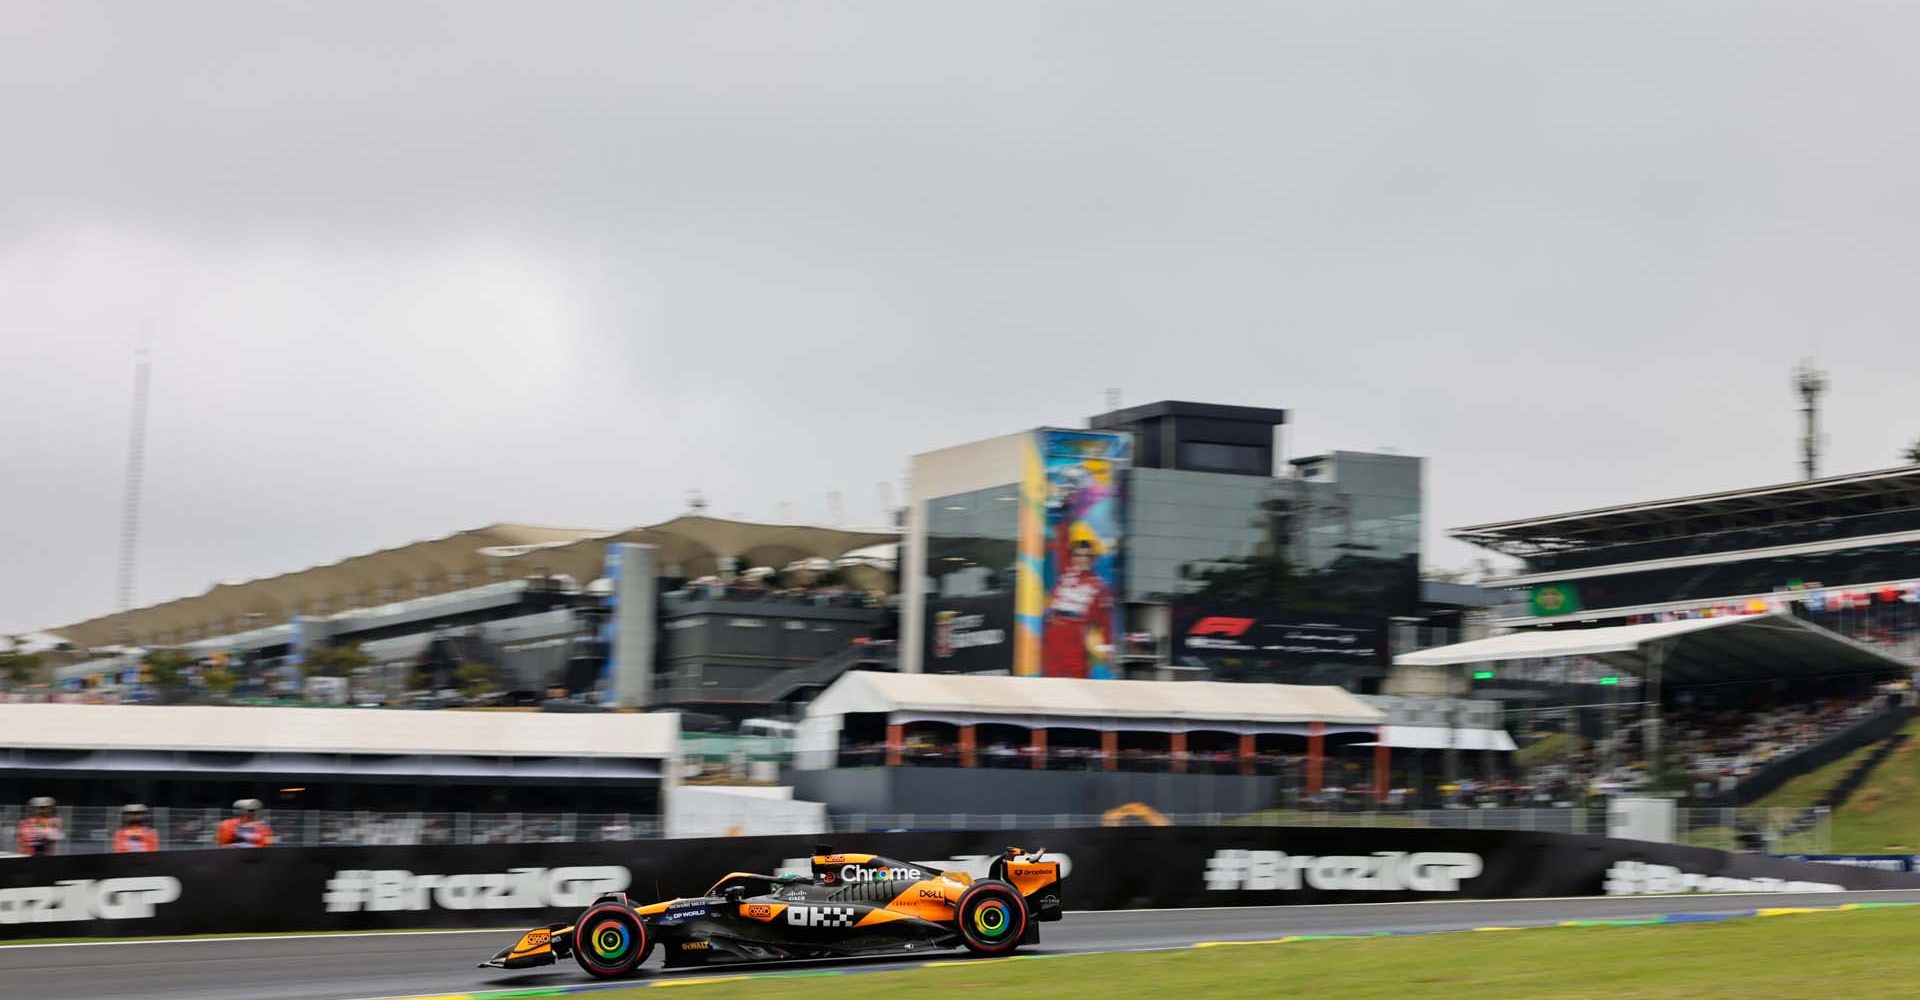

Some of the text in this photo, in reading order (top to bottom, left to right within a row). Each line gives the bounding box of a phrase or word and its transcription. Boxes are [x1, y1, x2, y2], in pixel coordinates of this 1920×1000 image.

[841, 864, 920, 881] Chrome
[1203, 849, 1484, 892] #BrazilGP
[322, 866, 632, 912] #BrazilGP
[919, 889, 944, 899] DELL
[788, 906, 854, 927] OKX
